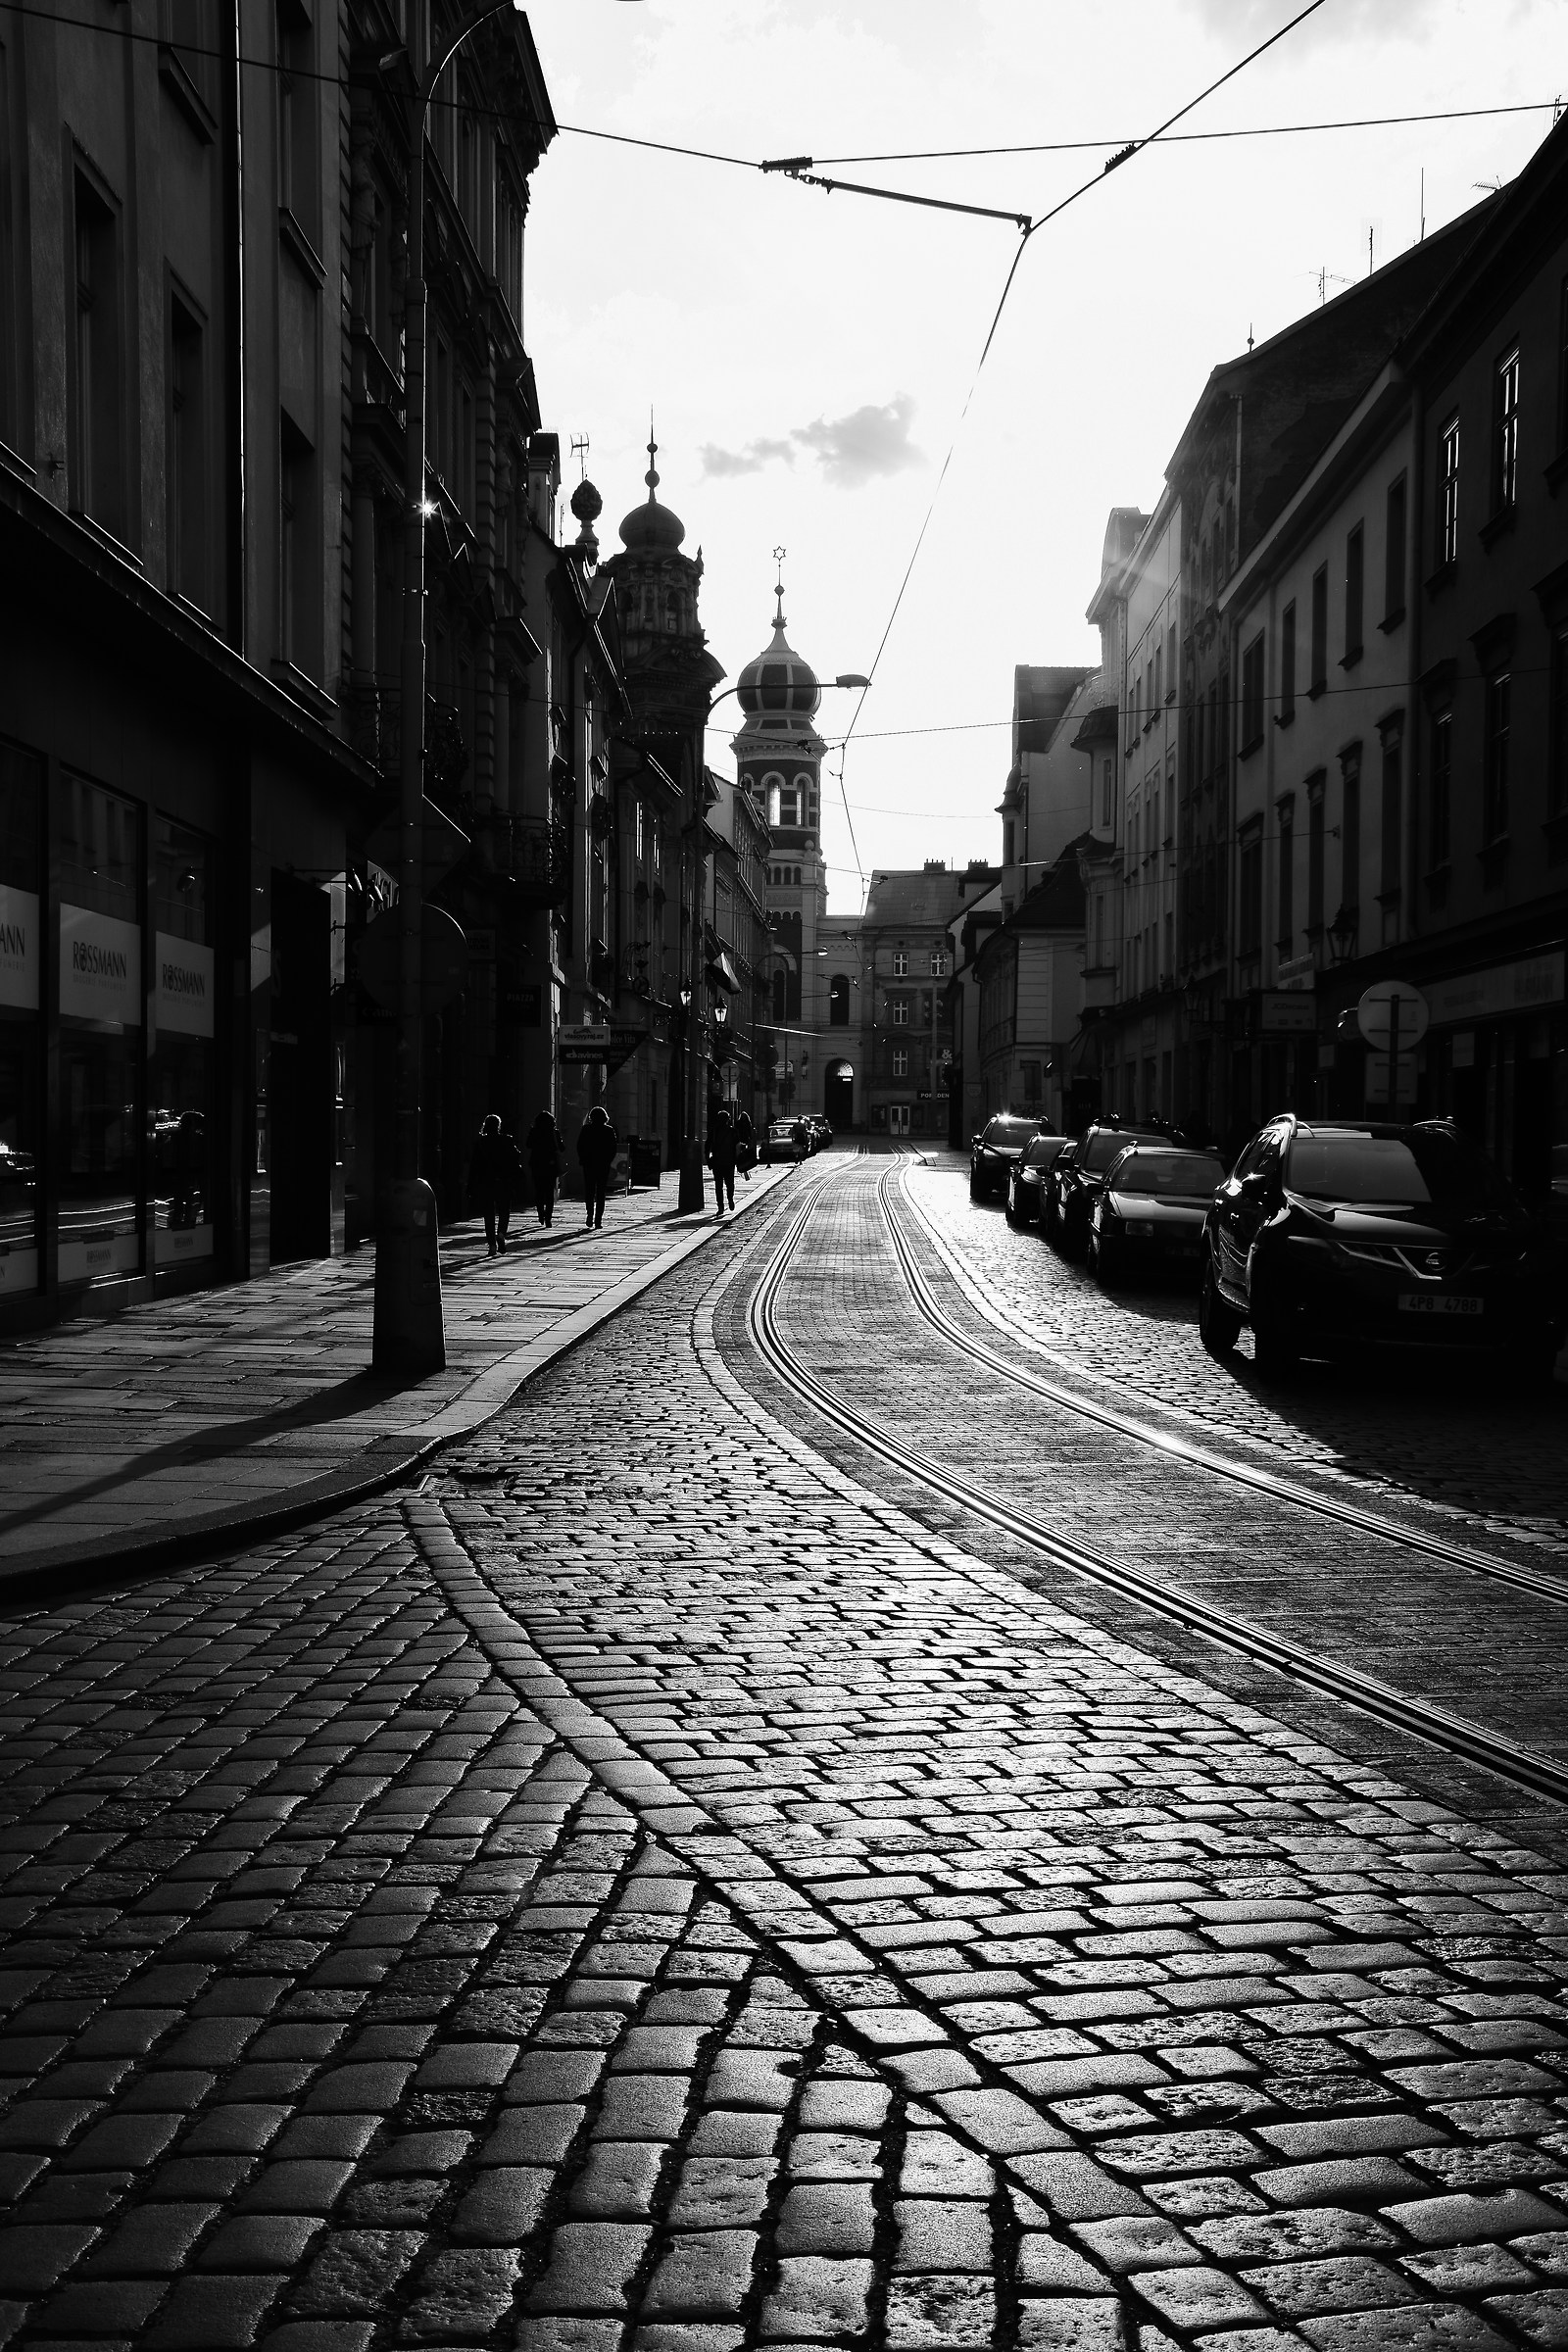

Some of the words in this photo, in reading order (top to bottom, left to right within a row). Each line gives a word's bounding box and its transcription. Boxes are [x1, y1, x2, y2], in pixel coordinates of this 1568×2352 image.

[74, 941, 126, 978] ROSSMANN
[163, 963, 205, 997] ROSSMANN
[507, 993, 534, 1003] PIAZZA
[1409, 1297, 1434, 1310] 4P8
[1445, 1298, 1477, 1312] 4788
